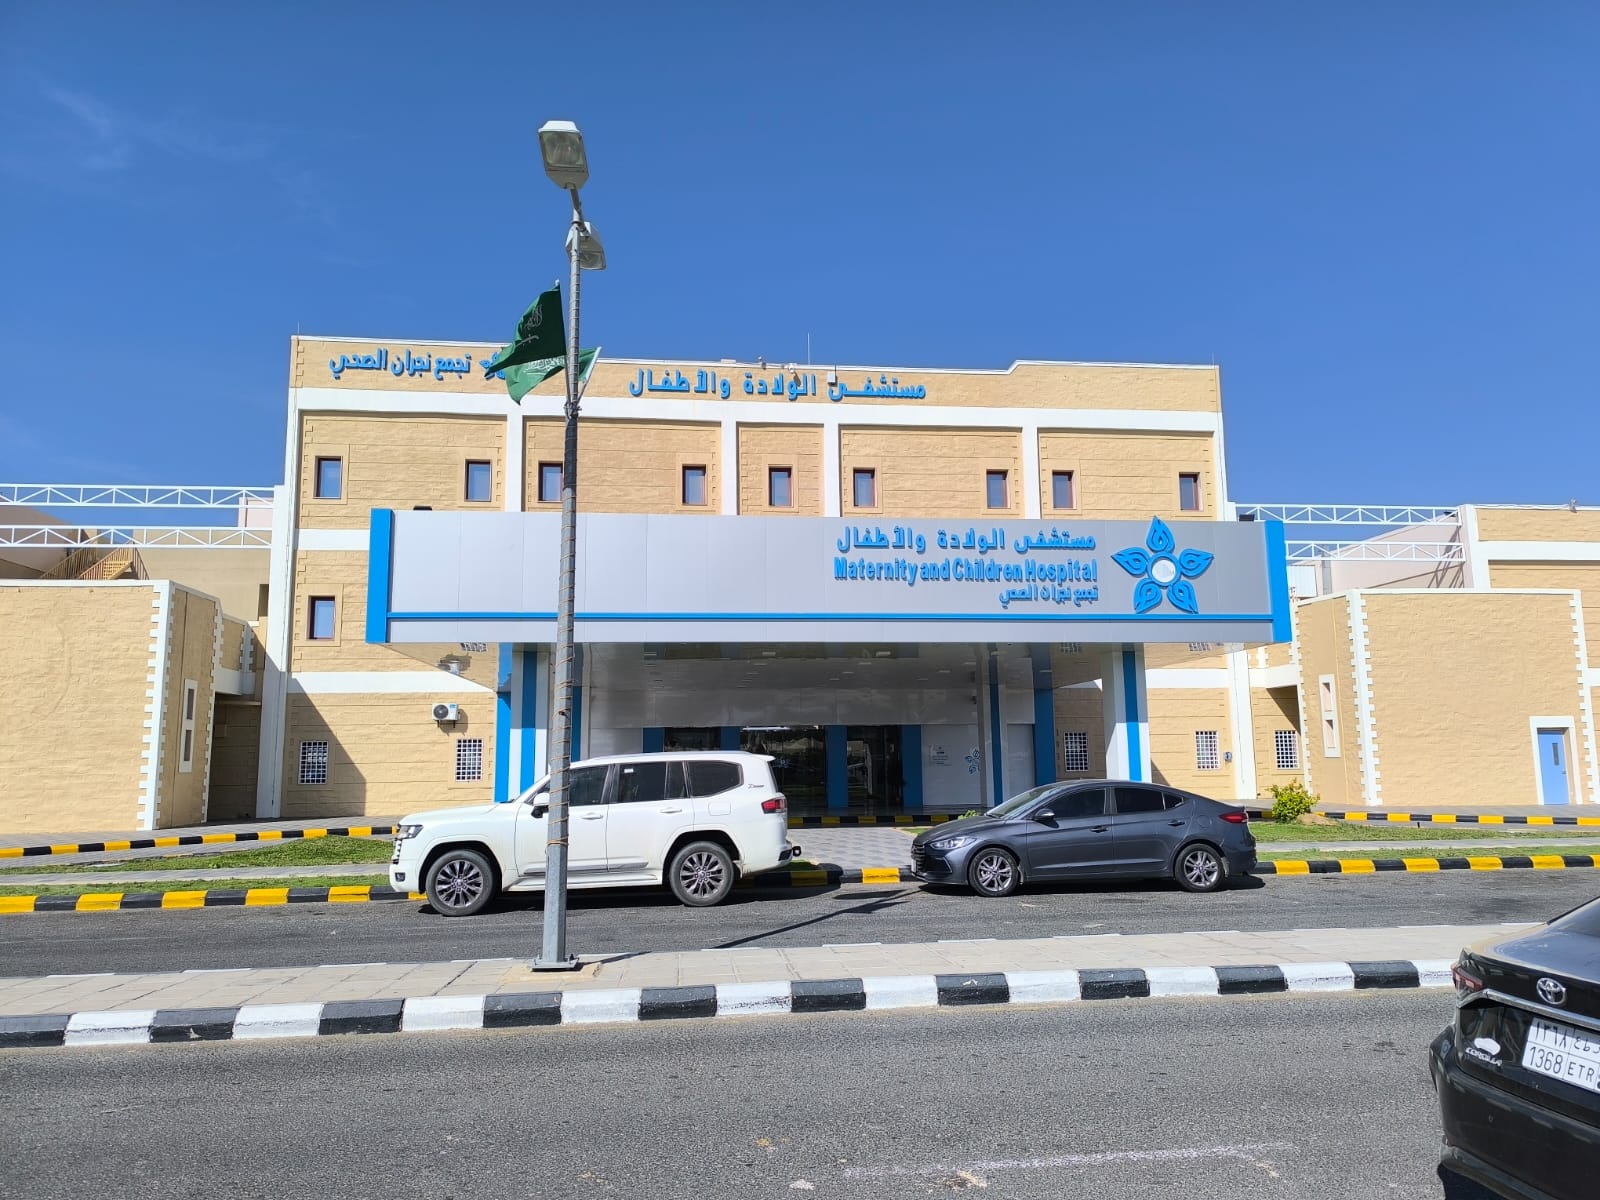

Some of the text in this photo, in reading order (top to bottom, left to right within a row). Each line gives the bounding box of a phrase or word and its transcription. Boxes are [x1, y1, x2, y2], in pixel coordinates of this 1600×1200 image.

[329, 347, 472, 381] تجمع نجران الصحي
[629, 367, 926, 401] مستشفى الولادة والأطفال
[837, 525, 1096, 554] مستشفى الولادة والأطفال
[834, 556, 1098, 587] Maternity and Children Hospital
[1529, 1046, 1595, 1082] 1368 ETR
